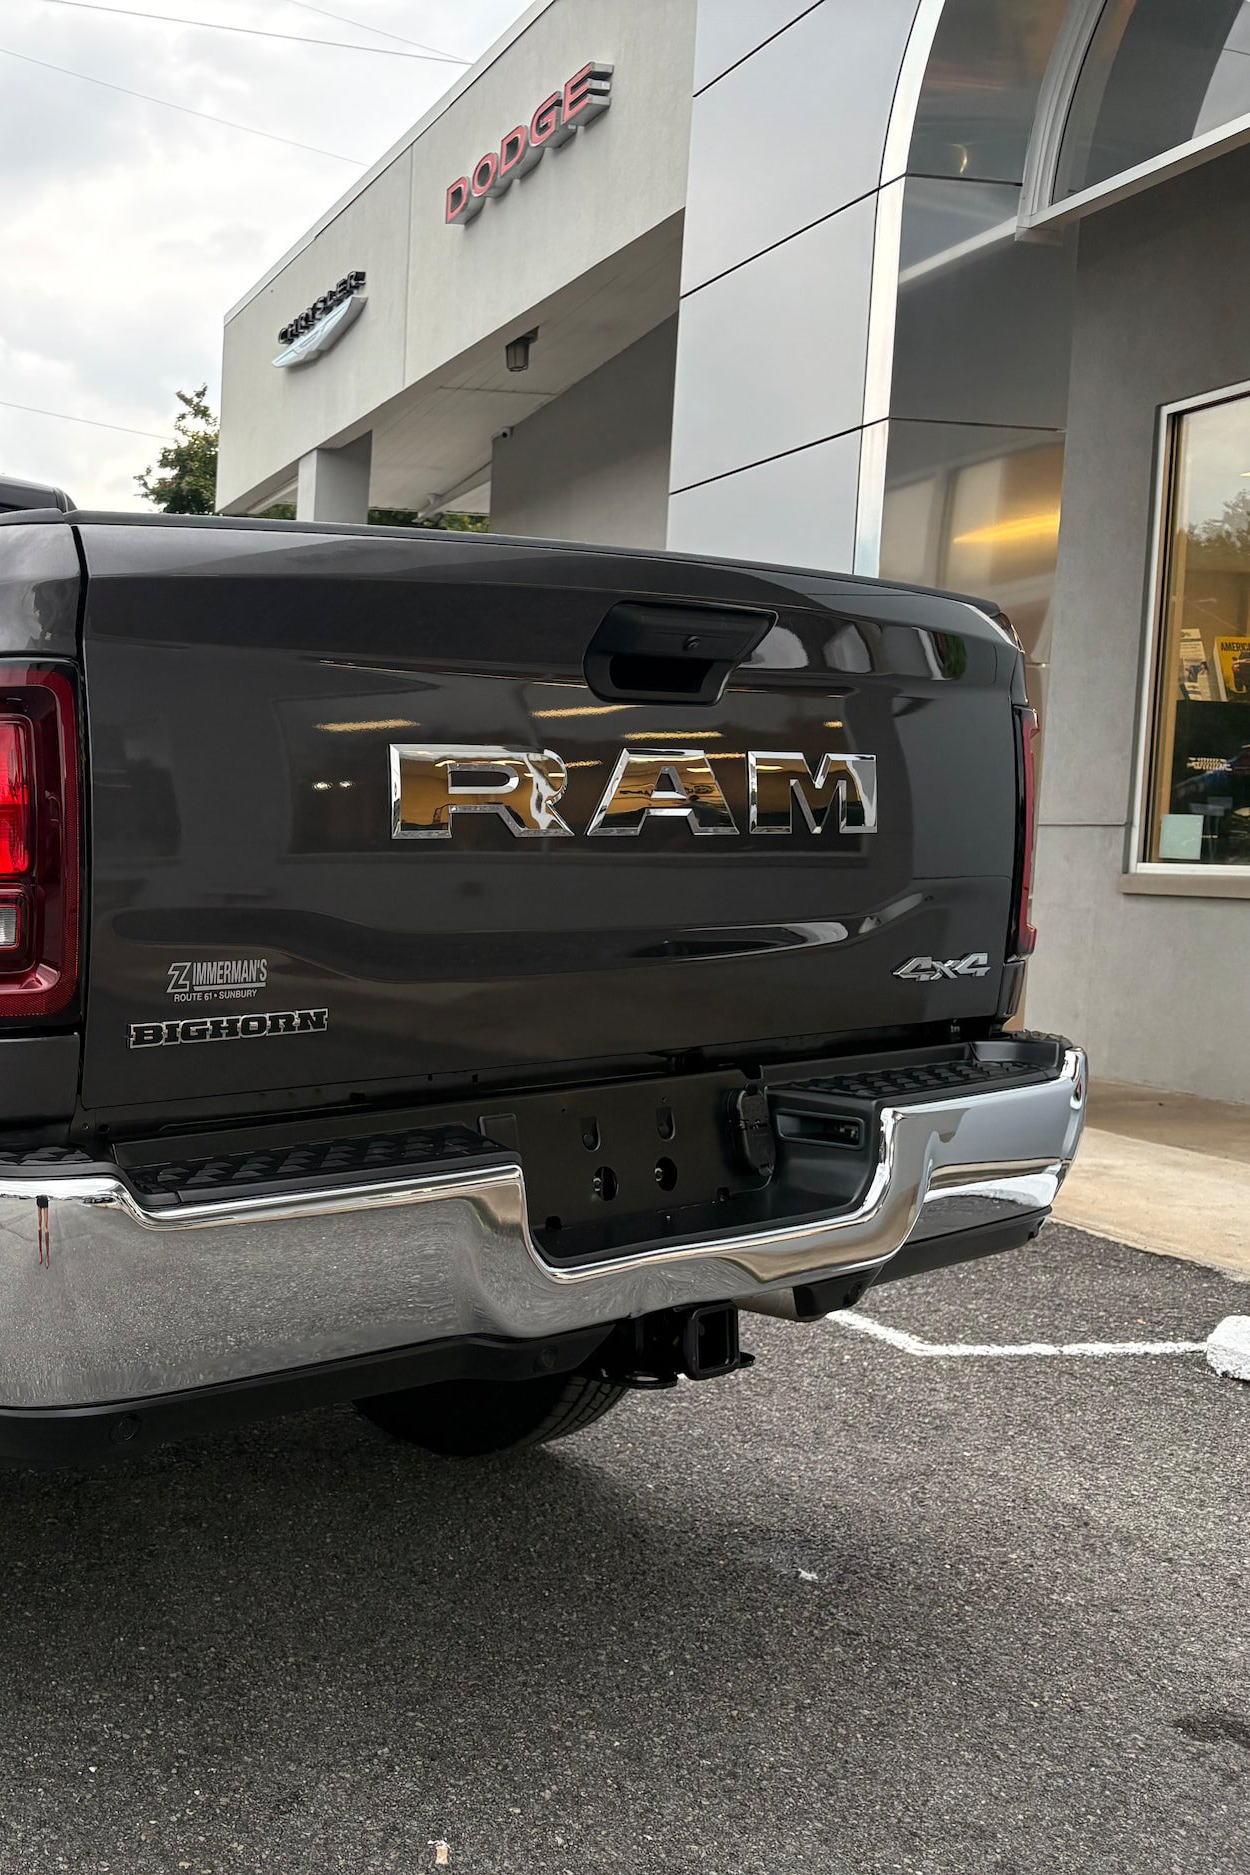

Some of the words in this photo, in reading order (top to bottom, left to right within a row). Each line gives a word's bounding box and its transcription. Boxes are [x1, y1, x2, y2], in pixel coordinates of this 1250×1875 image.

[445, 62, 614, 225] DODGE
[389, 743, 878, 839] RAM
[166, 958, 268, 994] ZIMMERMAN'S
[174, 992, 203, 1003] ROUTE
[205, 992, 213, 1001] 61
[218, 989, 258, 1000] SUNBURY
[128, 1007, 329, 1050] BIGHORN
